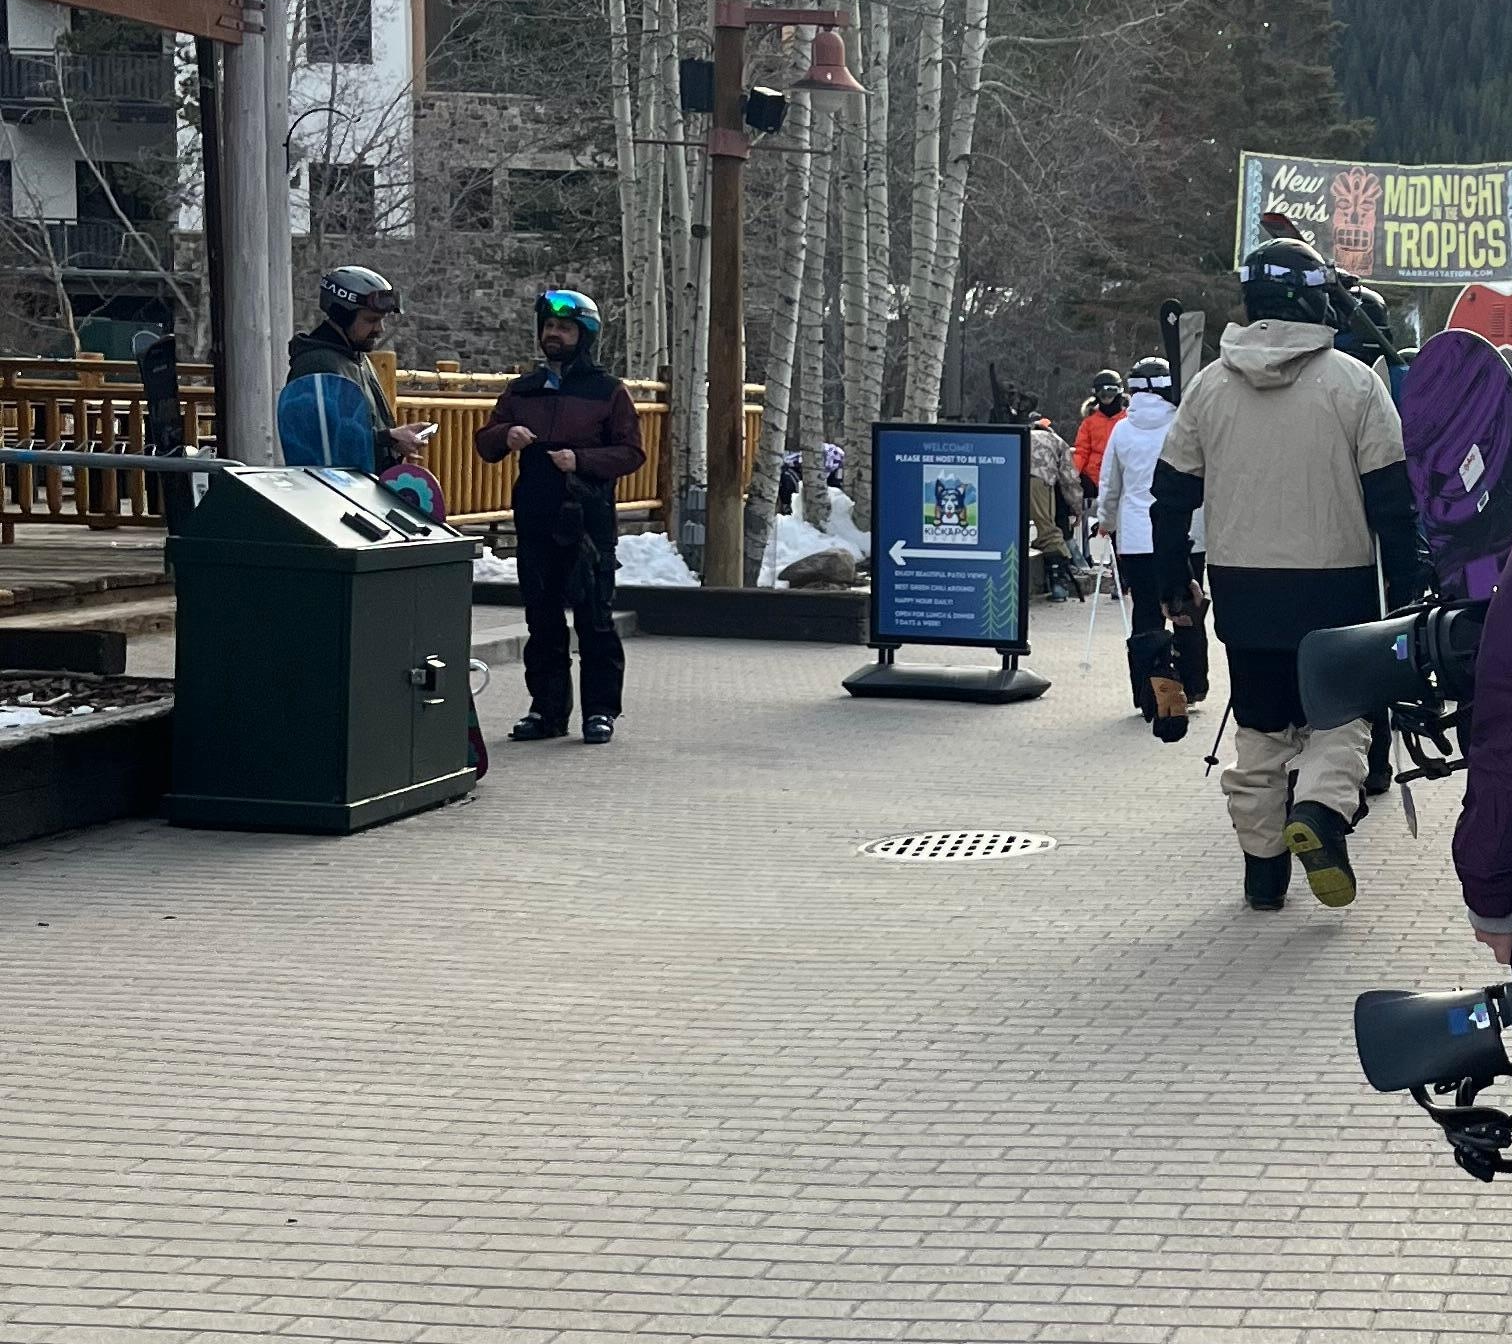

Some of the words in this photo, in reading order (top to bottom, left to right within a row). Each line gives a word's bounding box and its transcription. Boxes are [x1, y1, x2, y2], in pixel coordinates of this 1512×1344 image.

[1271, 164, 1325, 193] New
[1264, 191, 1330, 223] Year's
[923, 442, 975, 452] WELCOME!
[895, 454, 920, 463] PLEASE
[922, 455, 935, 463] SEE
[936, 455, 955, 464] HOST
[957, 456, 967, 464] TO
[968, 456, 977, 464] BE
[979, 457, 1006, 465] SEATED
[924, 527, 977, 537] KICKAPOO
